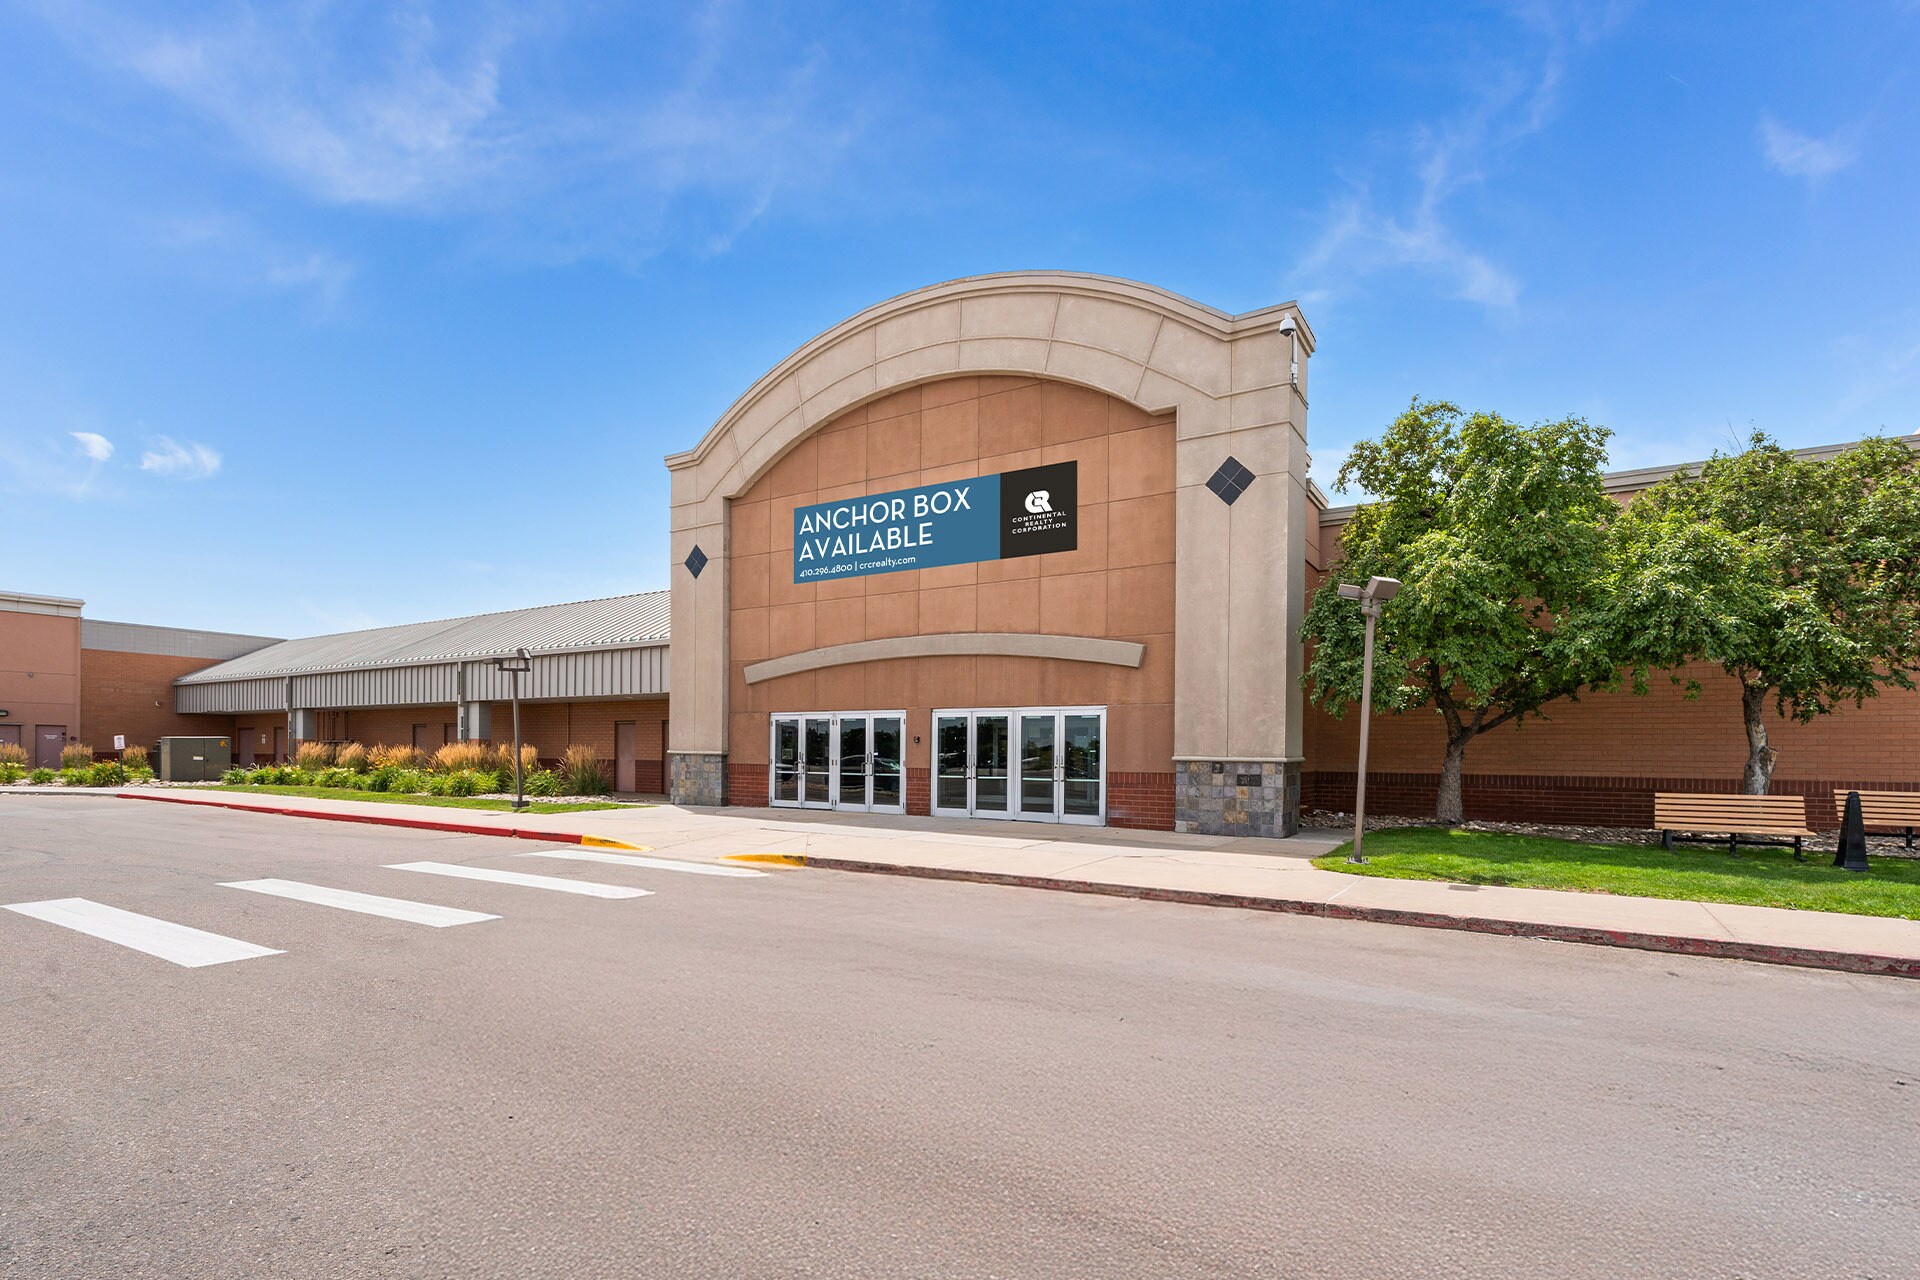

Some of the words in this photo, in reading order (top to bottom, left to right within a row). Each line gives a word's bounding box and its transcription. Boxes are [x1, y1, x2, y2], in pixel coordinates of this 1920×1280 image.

[799, 498, 907, 535] ANCHOR
[914, 486, 972, 518] BOX
[1012, 511, 1067, 523] CONTINENTAL
[1012, 522, 1067, 534] CORPORATION
[1024, 518, 1053, 527] REALTY
[799, 520, 933, 562] AVAILABLE
[799, 563, 853, 578] 410.296.4800
[859, 556, 916, 570] crcrealty.com
